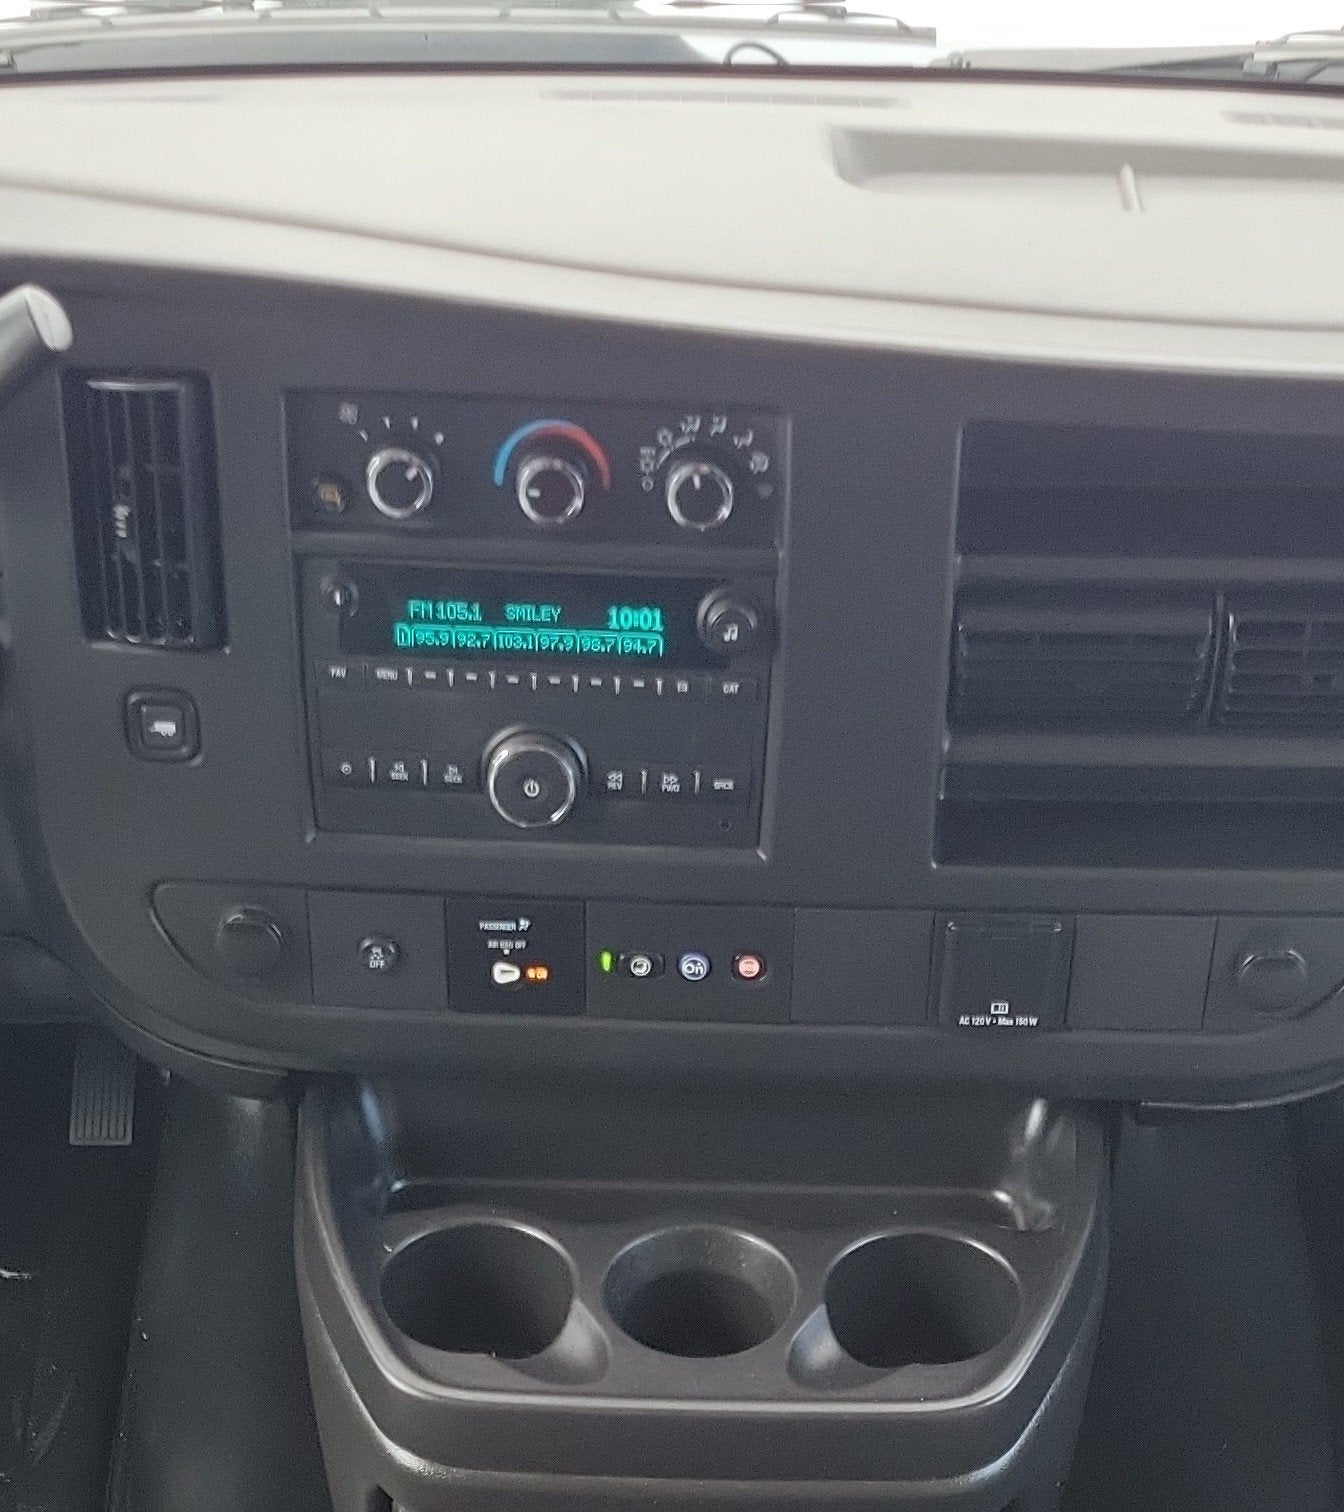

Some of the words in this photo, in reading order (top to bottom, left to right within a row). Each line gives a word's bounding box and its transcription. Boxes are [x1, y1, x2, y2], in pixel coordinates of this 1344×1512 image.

[505, 604, 562, 622] SMILEY
[608, 606, 664, 631] 10:01
[331, 667, 346, 678] FAV
[723, 682, 739, 694] CAT
